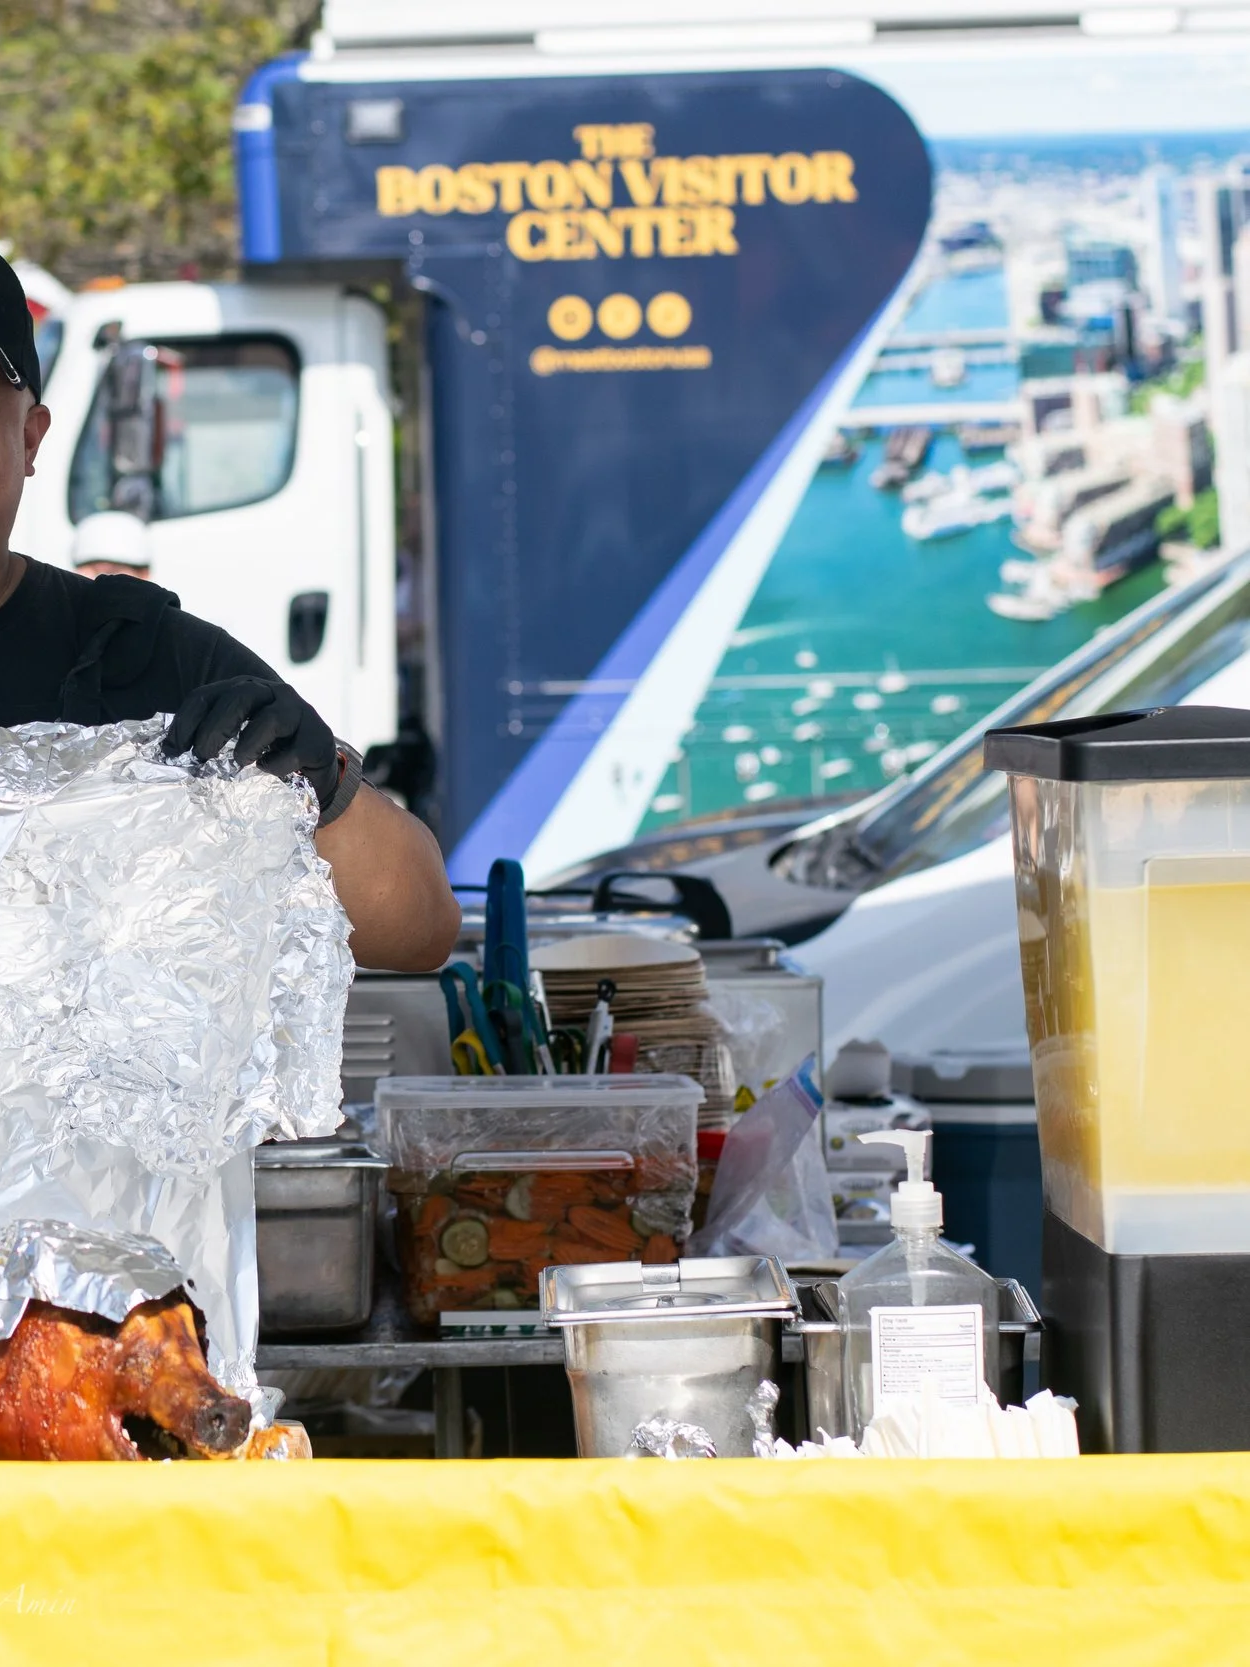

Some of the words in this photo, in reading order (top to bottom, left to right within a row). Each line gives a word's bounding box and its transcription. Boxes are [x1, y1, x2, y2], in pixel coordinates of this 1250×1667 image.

[573, 122, 655, 161] THE
[375, 159, 614, 217] BOSTON
[618, 151, 858, 208] VISITOR
[506, 206, 739, 262] CENTER
